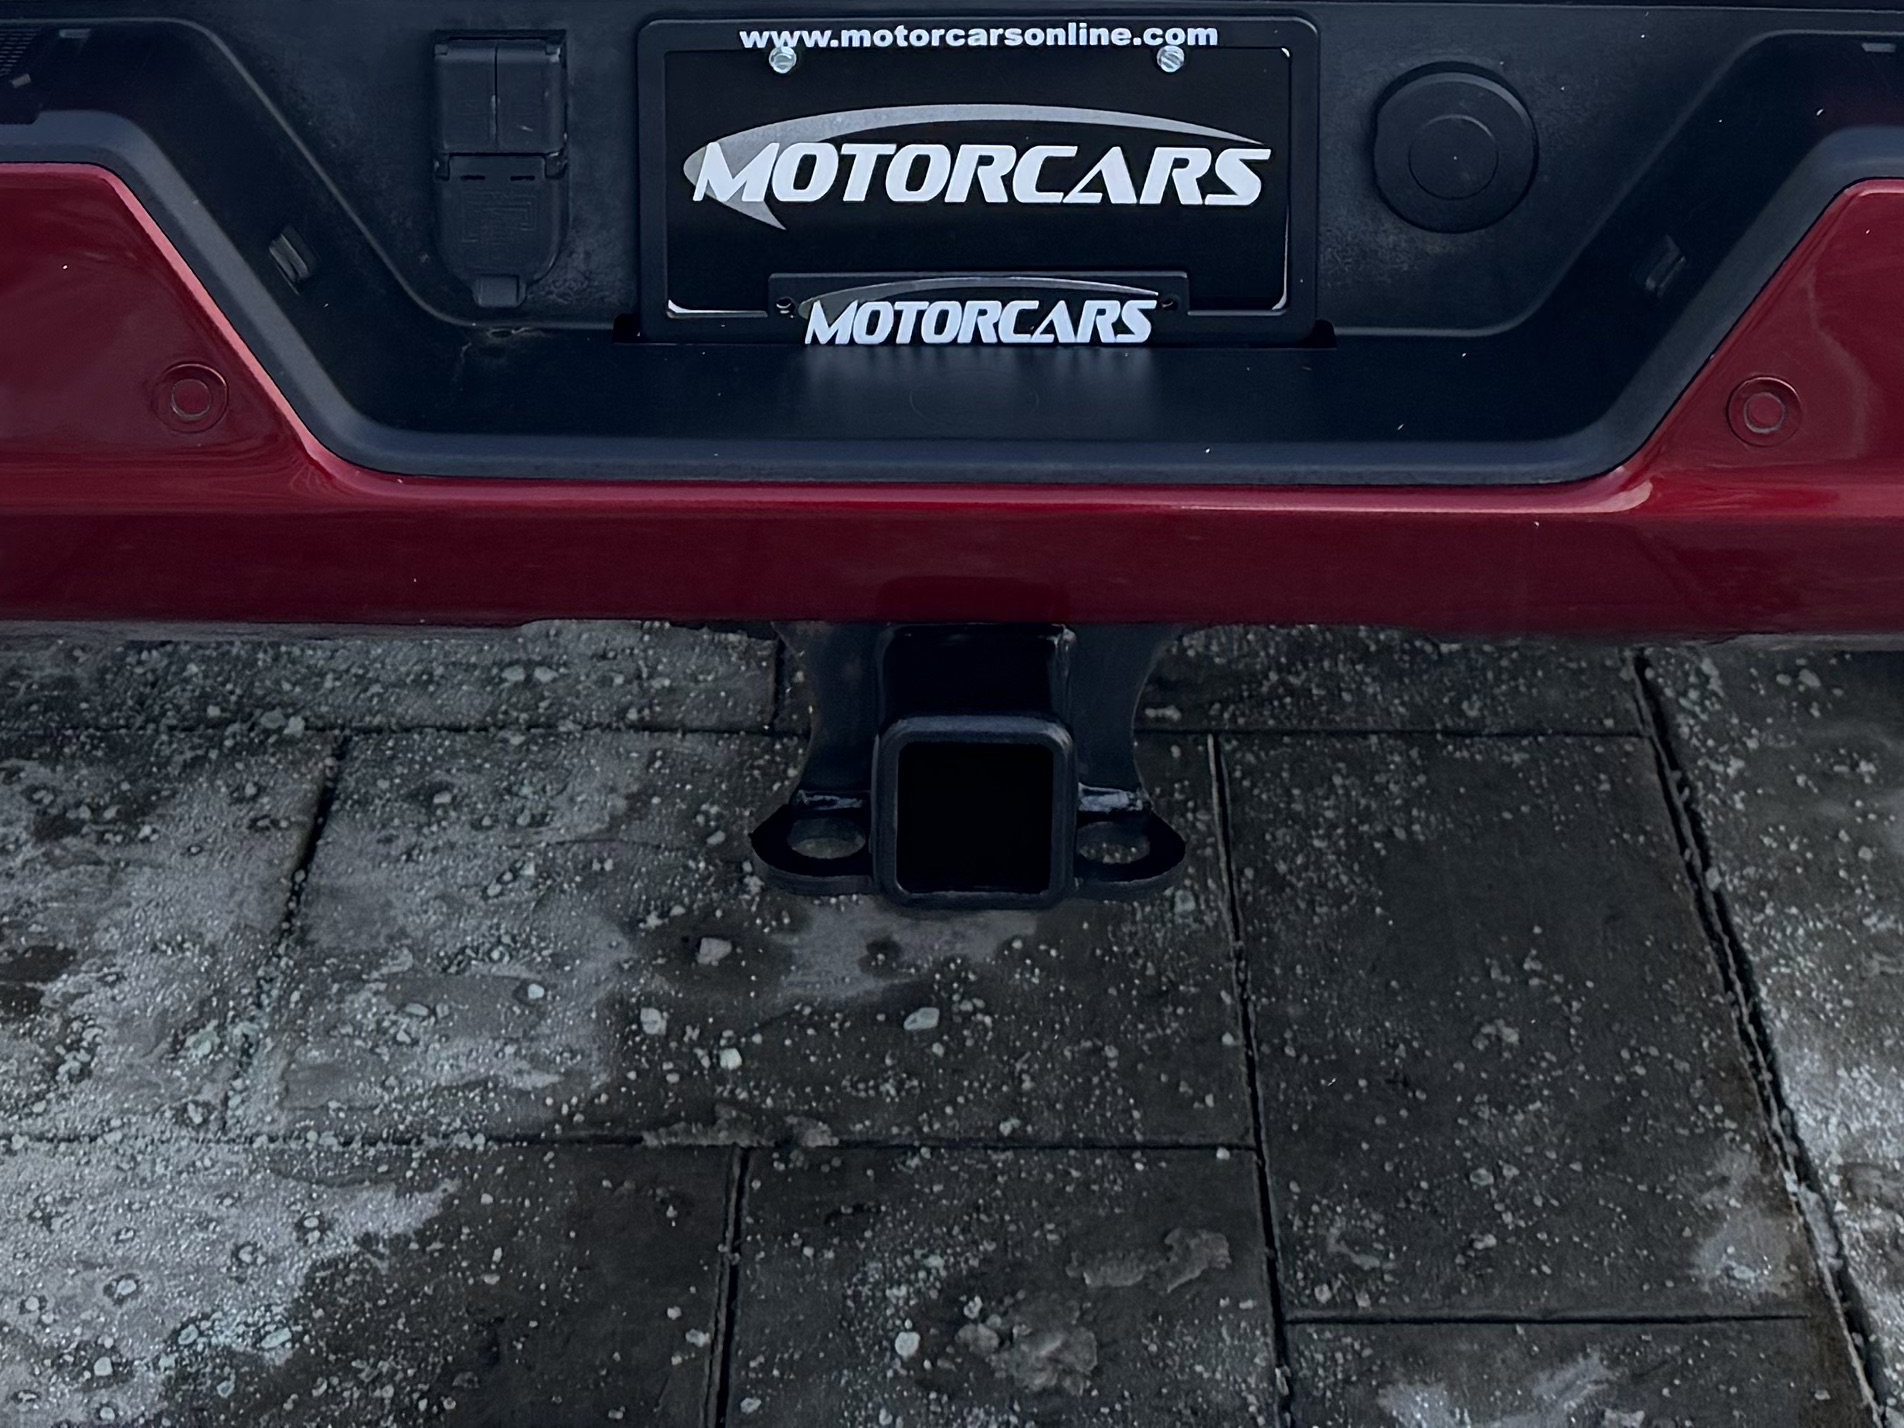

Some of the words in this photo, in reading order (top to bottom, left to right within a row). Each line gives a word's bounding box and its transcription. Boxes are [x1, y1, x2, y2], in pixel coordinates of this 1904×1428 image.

[739, 22, 1219, 49] www.motorcarsonline.com
[692, 142, 1272, 206] MOTORCARS
[804, 299, 1158, 345] MOTORCARS
